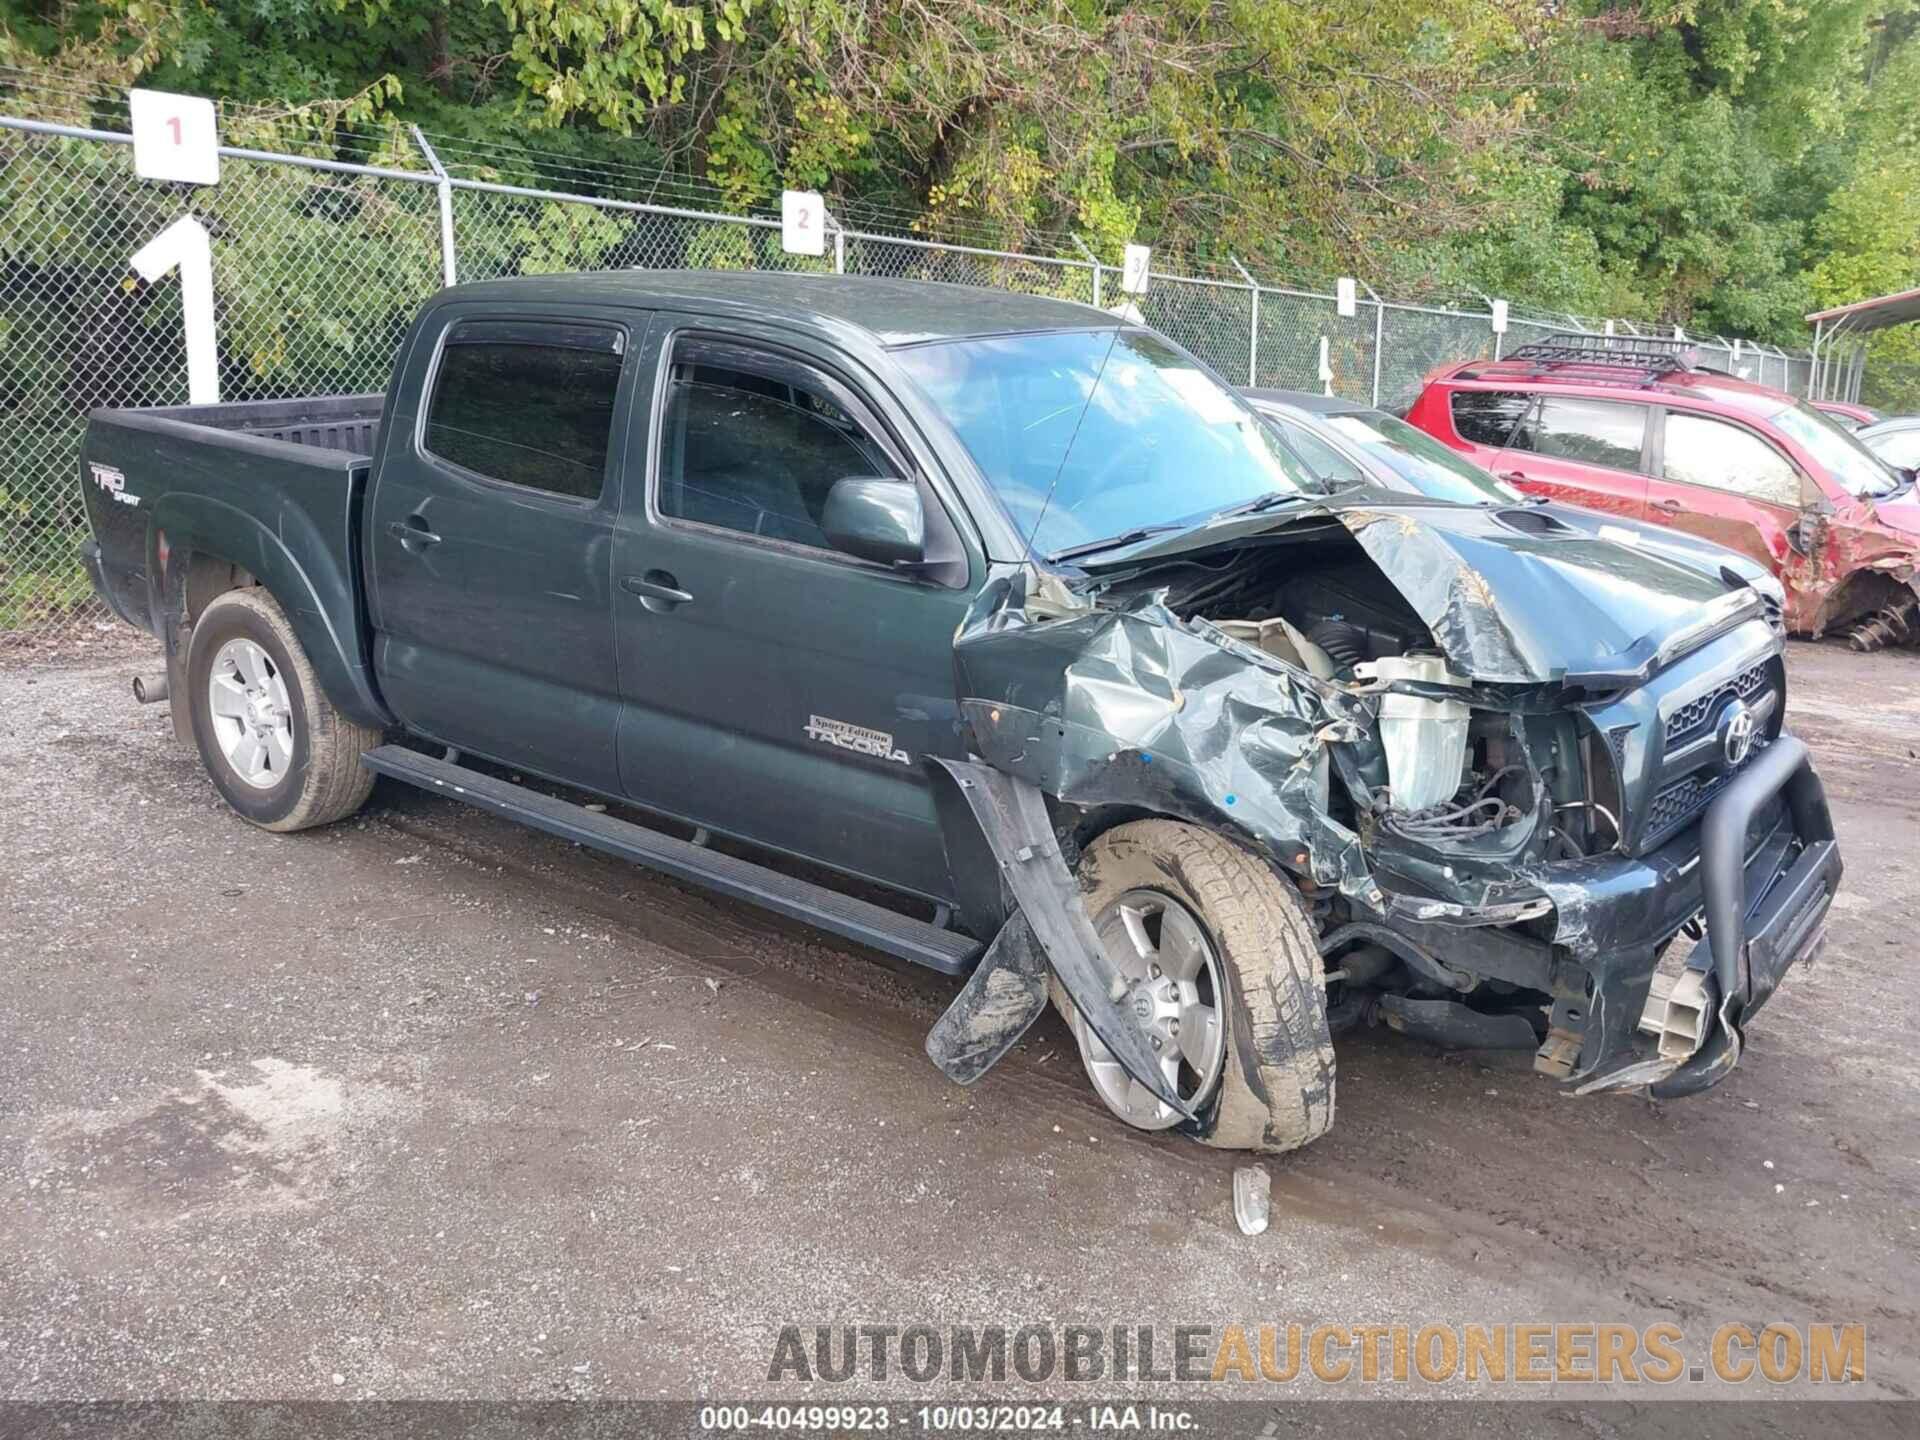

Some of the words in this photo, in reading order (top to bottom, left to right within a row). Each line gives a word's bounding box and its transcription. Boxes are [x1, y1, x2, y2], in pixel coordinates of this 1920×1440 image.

[166, 115, 183, 145] 1
[797, 207, 810, 230] 2
[1133, 257, 1142, 273] 3
[91, 466, 125, 493] TRD
[113, 491, 142, 507] SPORT
[815, 717, 846, 732] Sport
[848, 725, 889, 743] Edition
[802, 725, 912, 766] TACOMA
